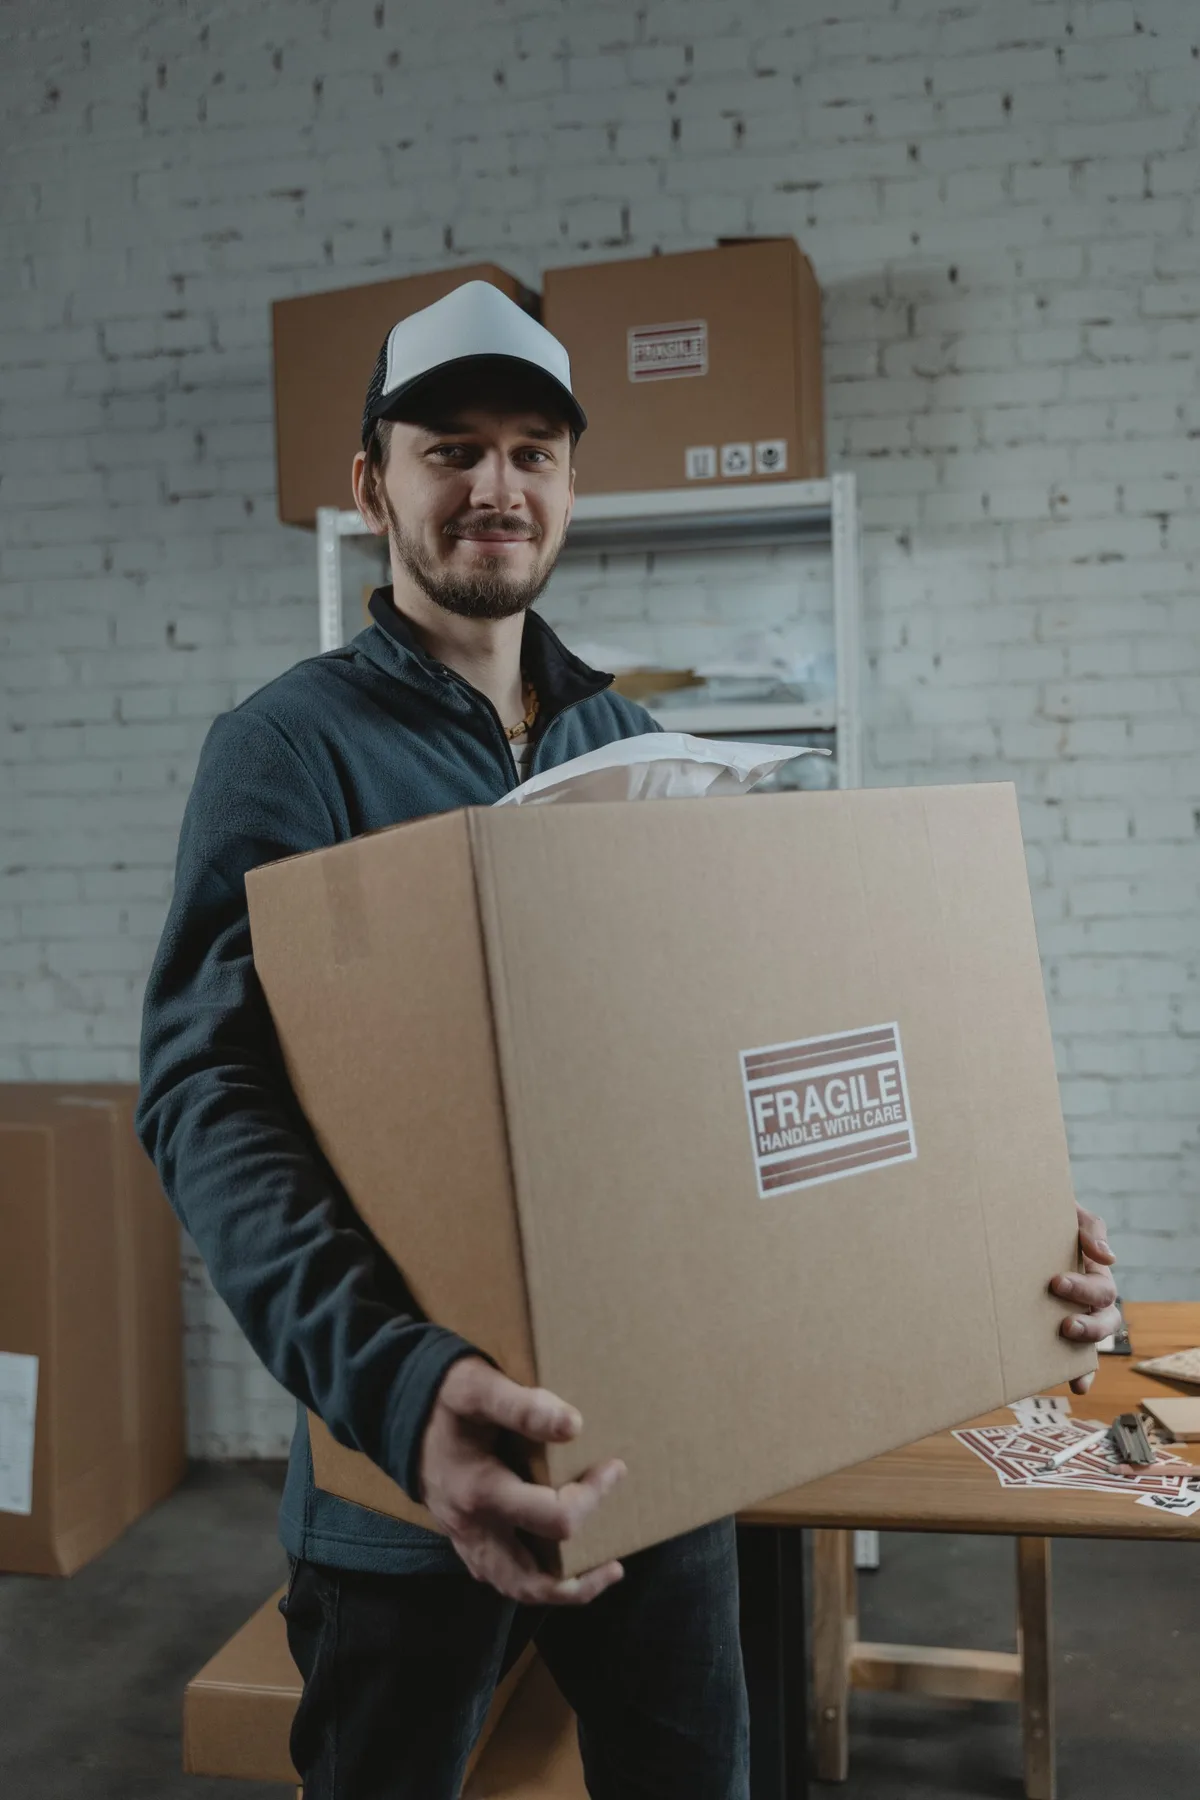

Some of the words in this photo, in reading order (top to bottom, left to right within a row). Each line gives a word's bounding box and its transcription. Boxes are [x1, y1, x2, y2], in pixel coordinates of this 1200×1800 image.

[753, 1068, 900, 1133] FRAGILE
[759, 1122, 822, 1152] HANDLE
[824, 1114, 861, 1136] WITH
[863, 1104, 902, 1127] CARE
